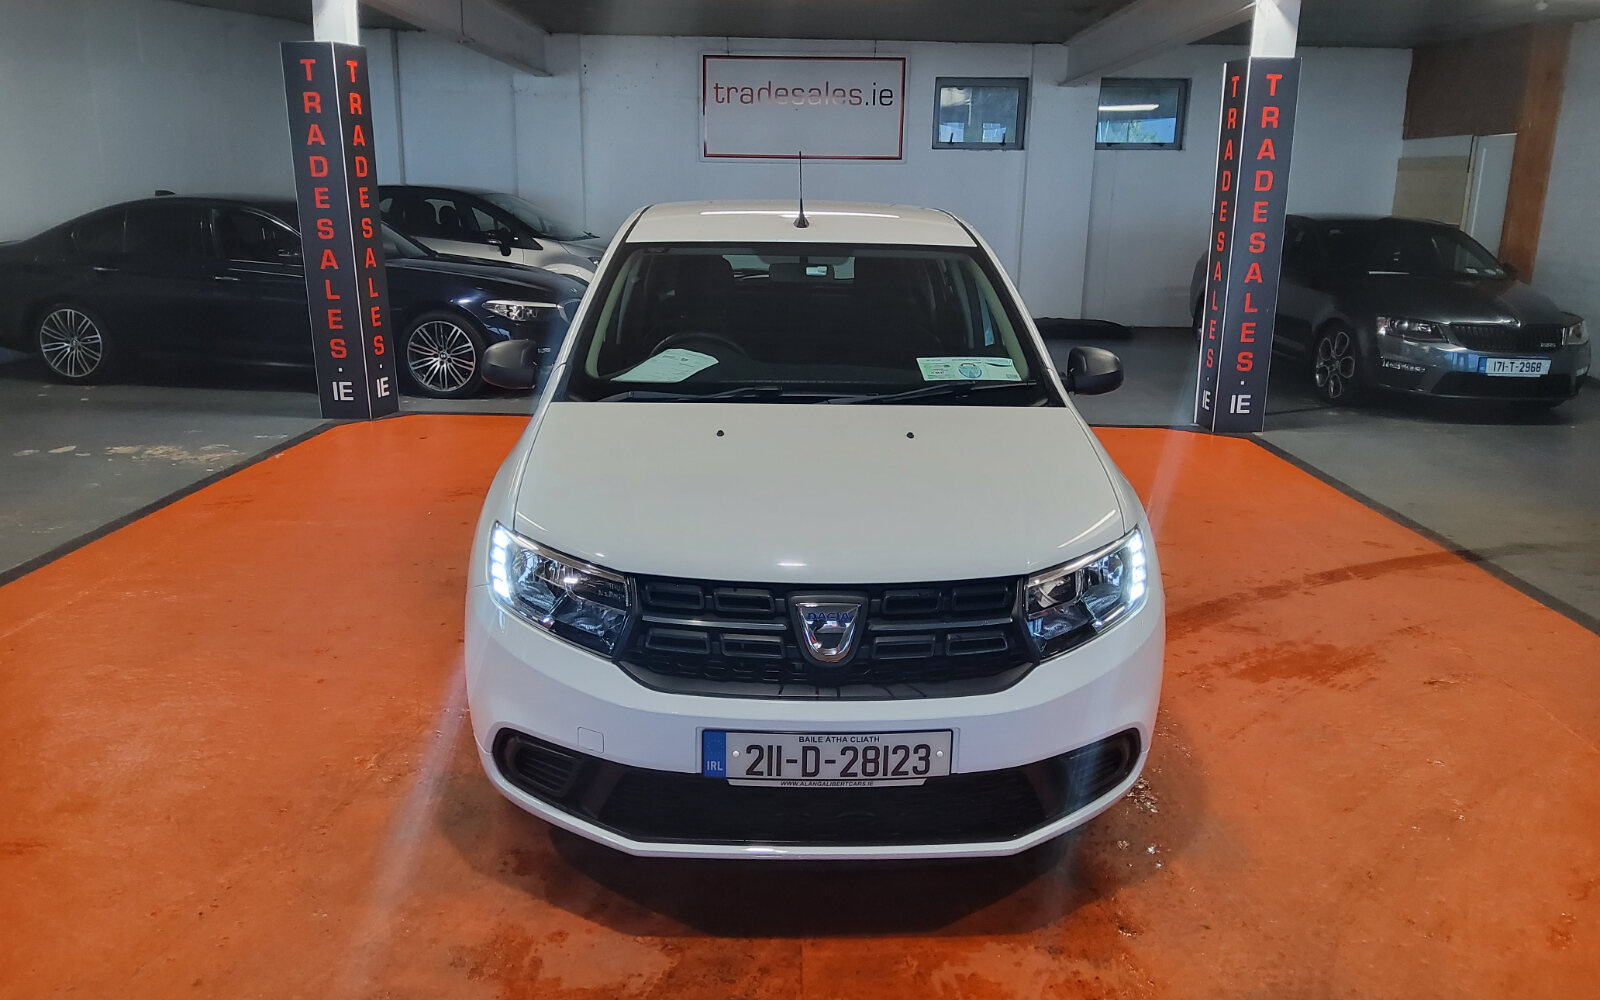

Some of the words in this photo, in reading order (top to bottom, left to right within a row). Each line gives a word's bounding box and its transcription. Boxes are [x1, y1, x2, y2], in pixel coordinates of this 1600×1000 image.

[713, 80, 894, 106] tradesales.ie
[1493, 361, 1542, 372] 171-T-2968
[807, 612, 852, 621] DACIA
[798, 735, 823, 743] BAILE
[850, 735, 880, 743] CLIATH
[706, 760, 723, 771] IRL
[745, 743, 931, 778] 211-D-28123
